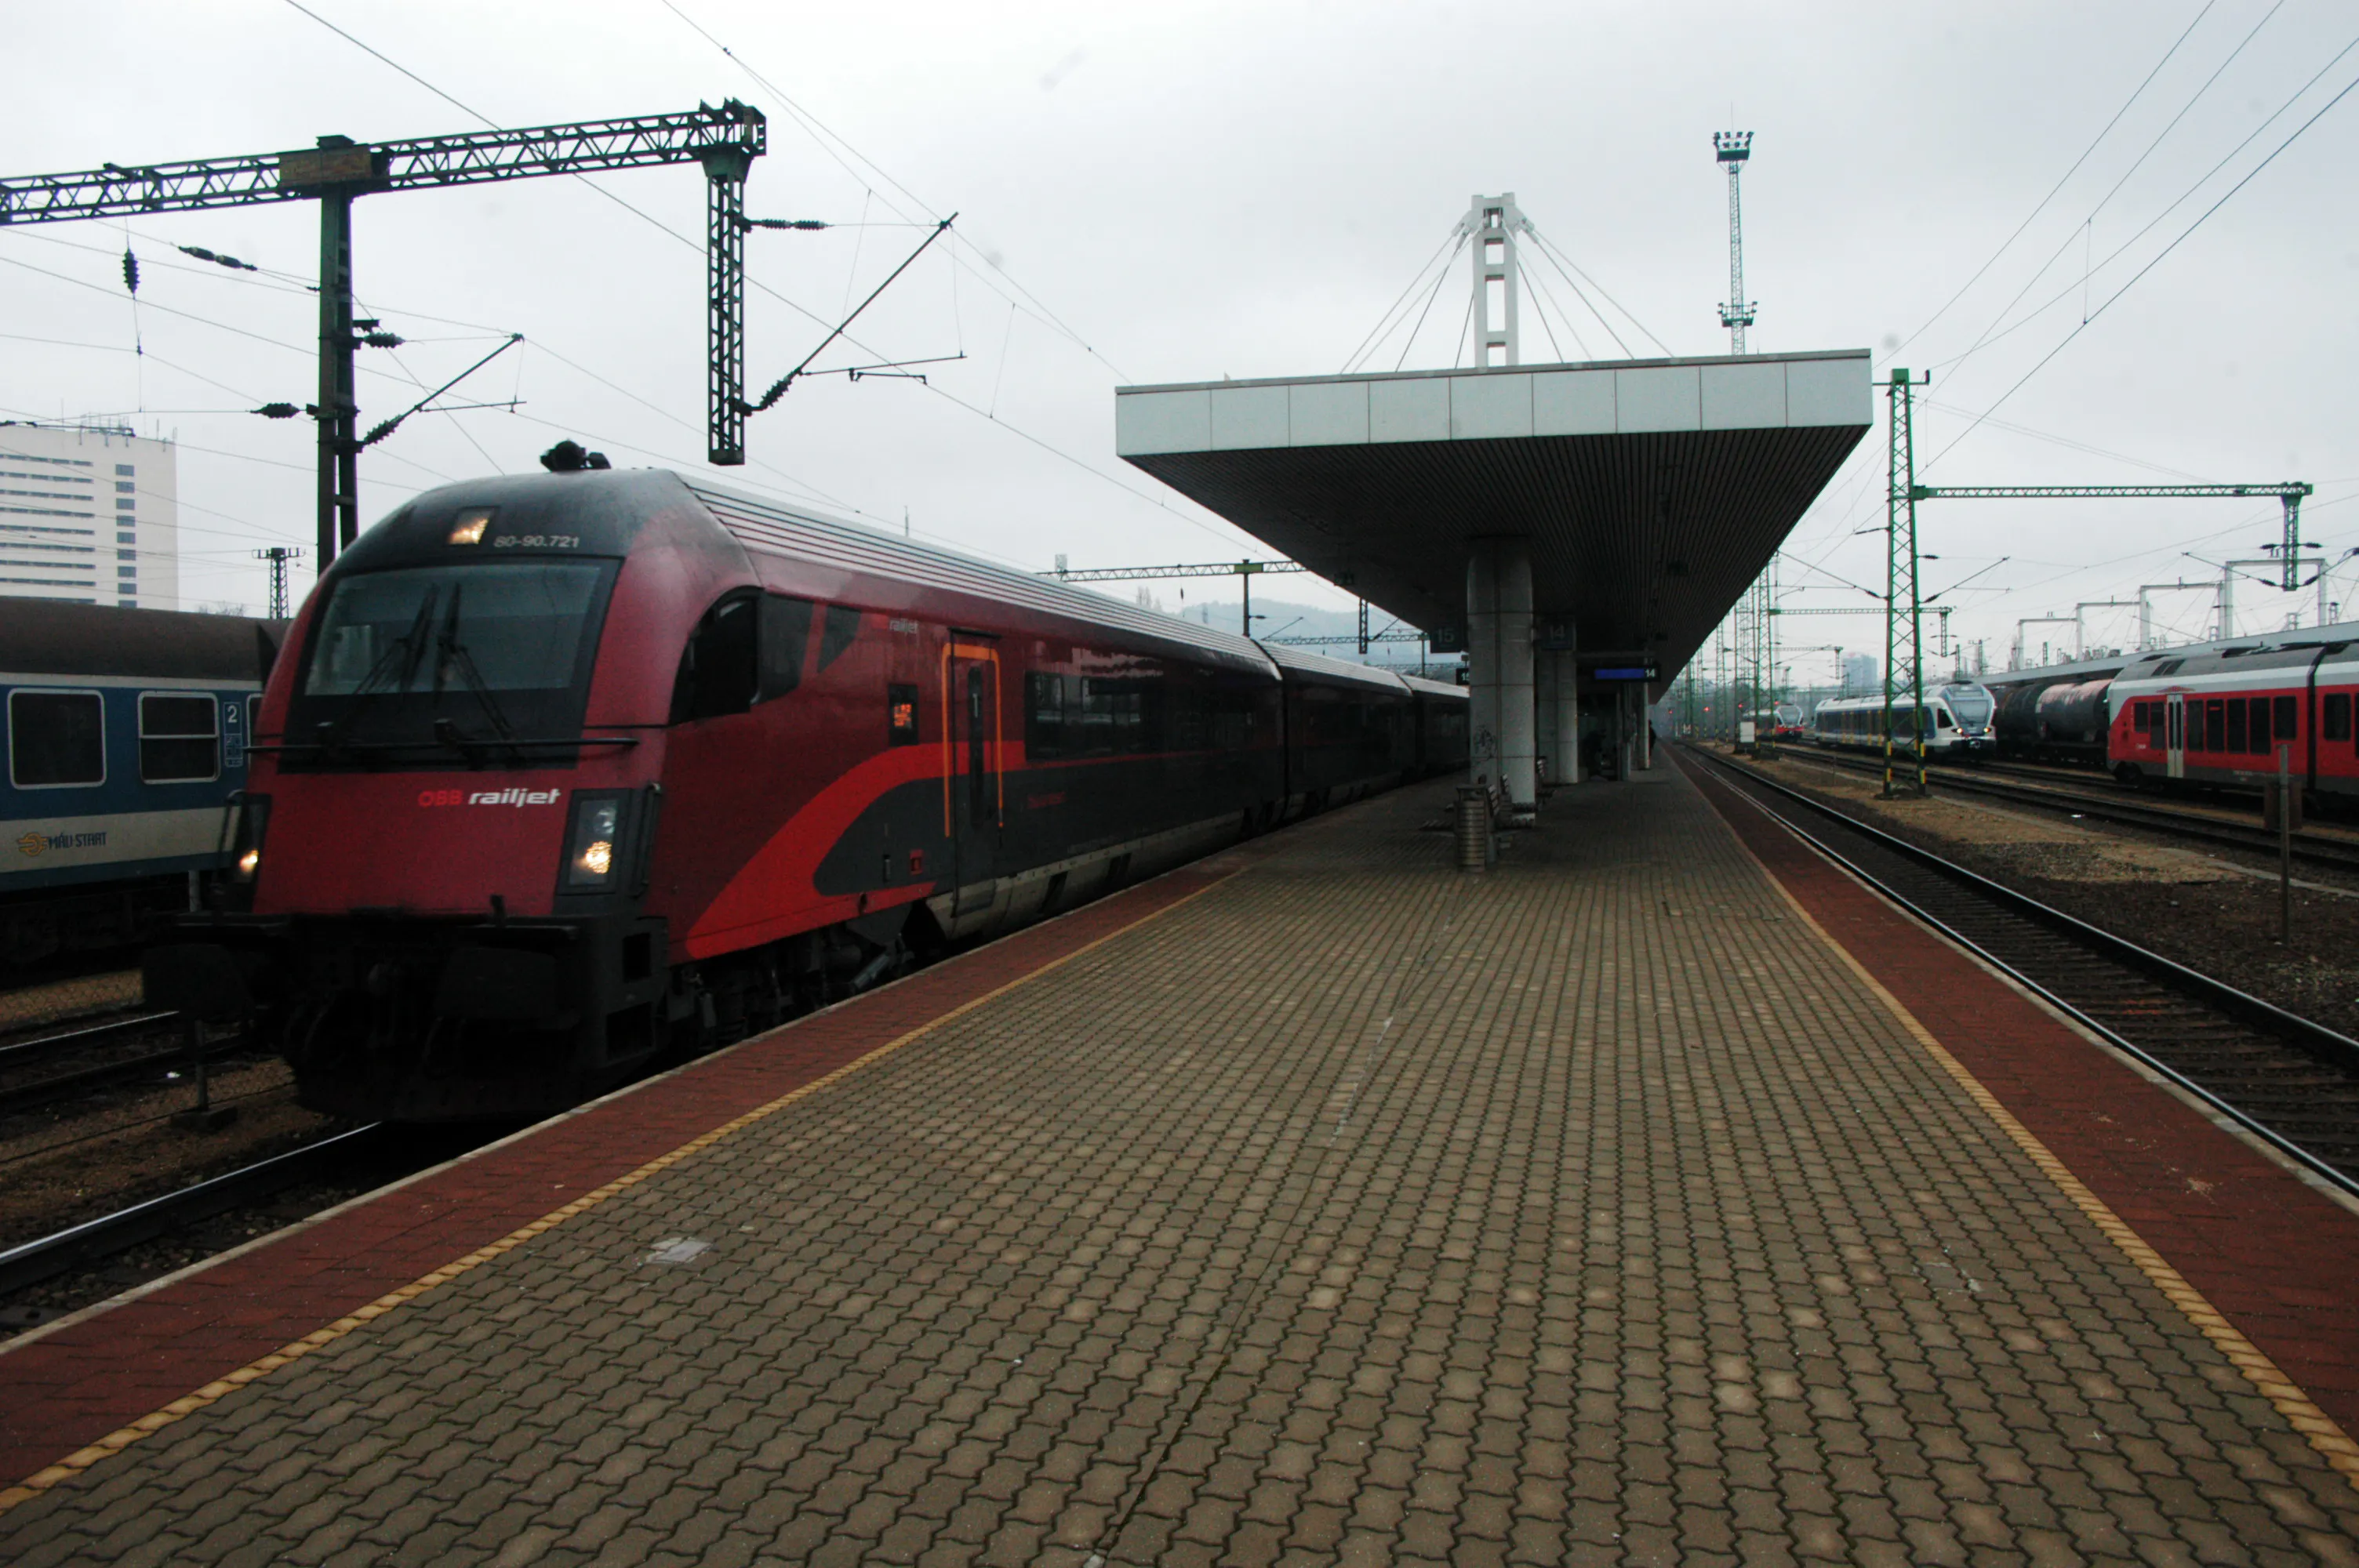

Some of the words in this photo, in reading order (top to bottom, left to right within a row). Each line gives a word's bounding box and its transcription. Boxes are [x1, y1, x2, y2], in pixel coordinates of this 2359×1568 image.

[493, 535, 580, 549] 80-90.721
[1438, 627, 1455, 644] 15
[1550, 624, 1565, 640] 14
[1645, 669, 1656, 678] 14
[227, 704, 238, 724] 2
[468, 788, 562, 808] railjet
